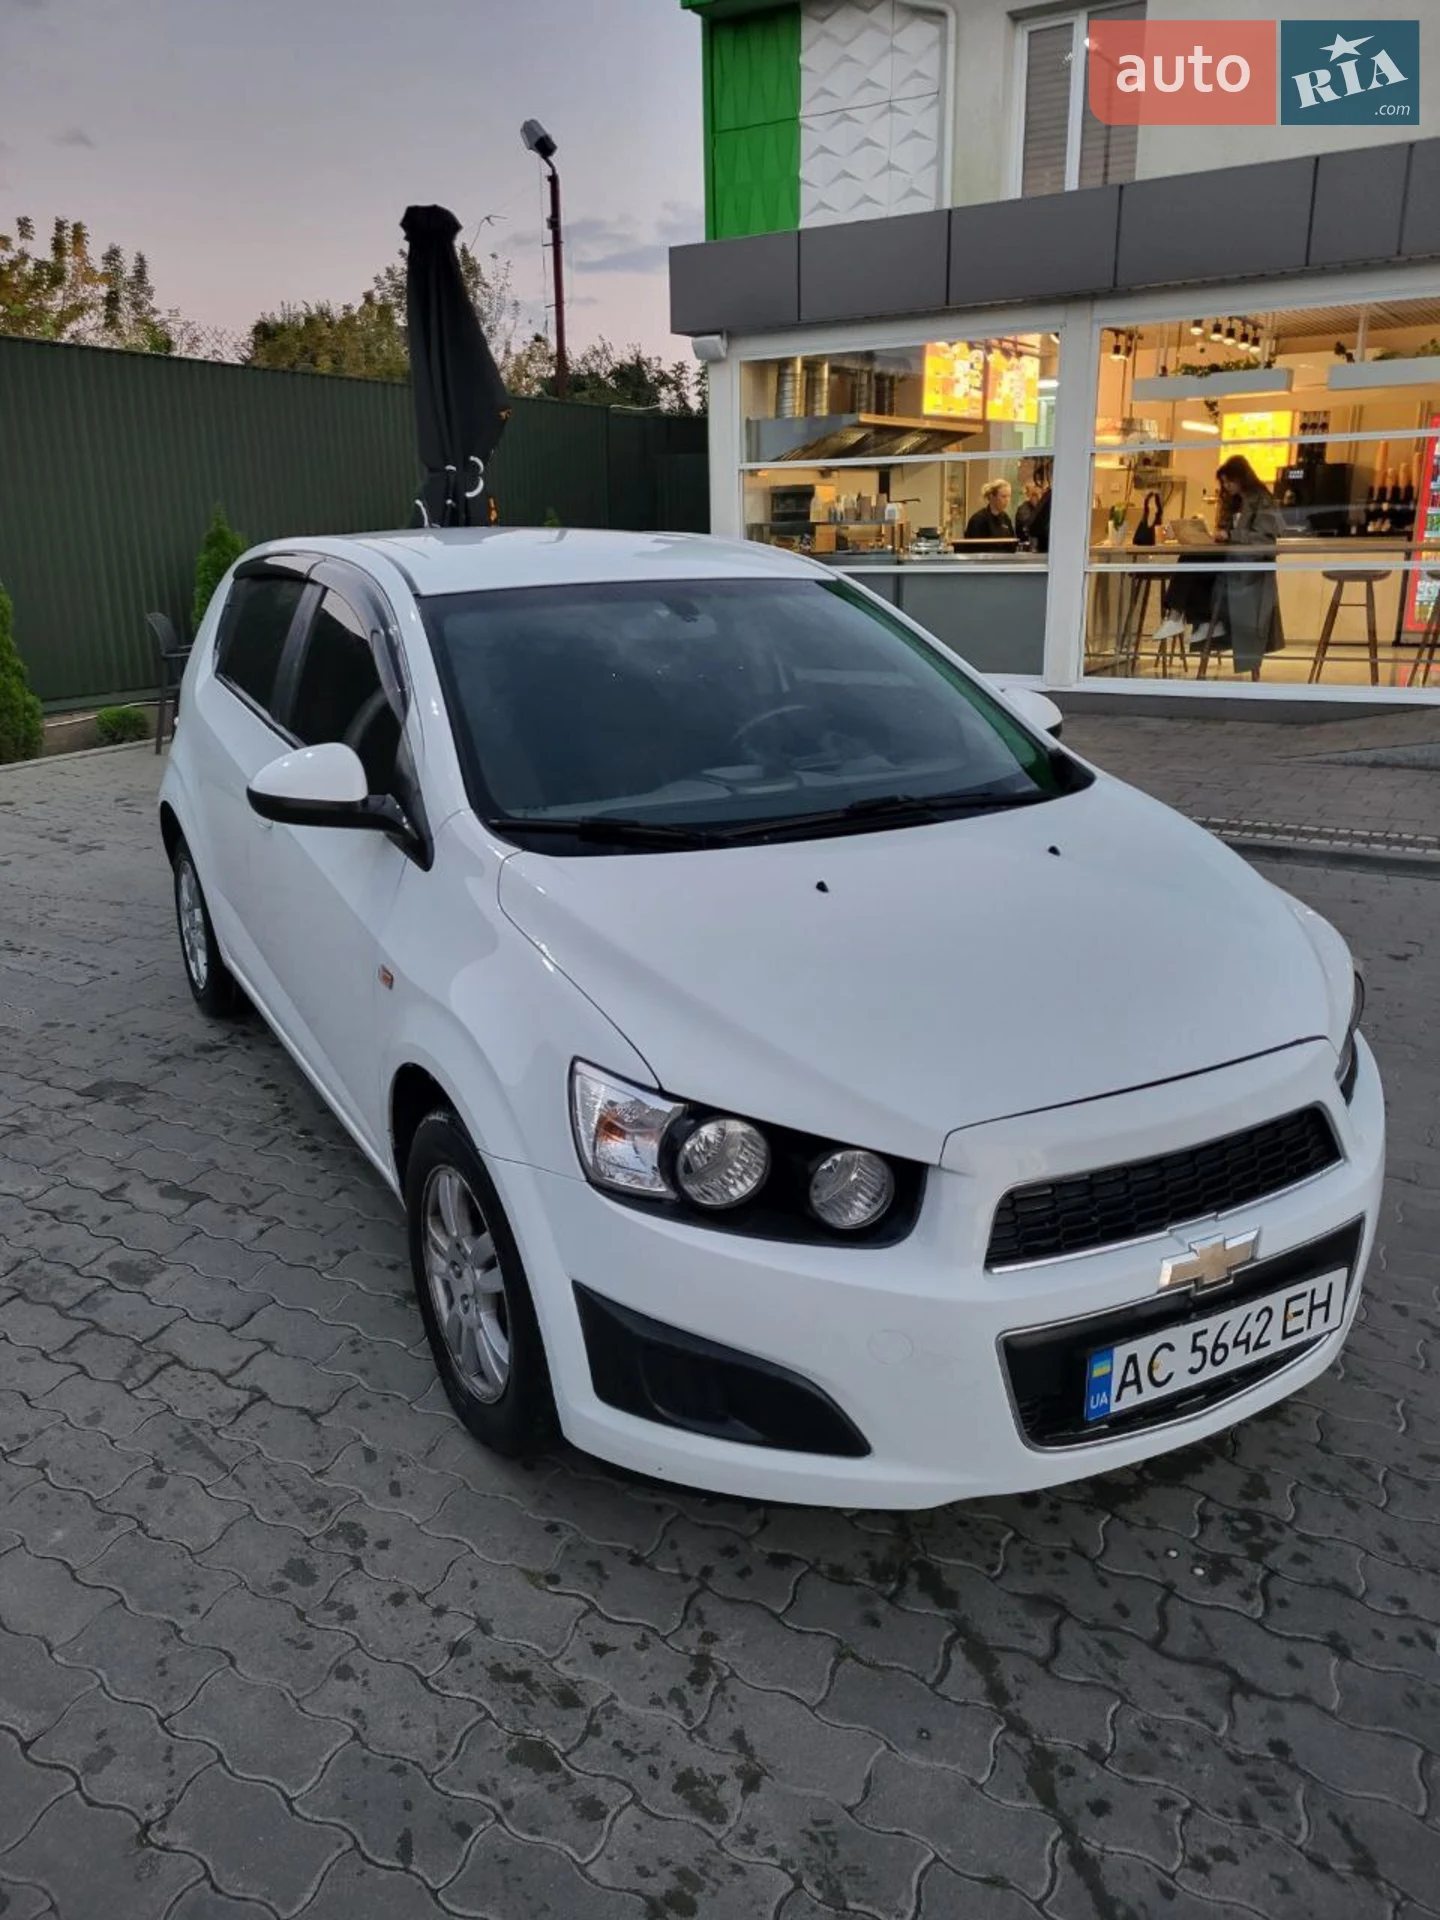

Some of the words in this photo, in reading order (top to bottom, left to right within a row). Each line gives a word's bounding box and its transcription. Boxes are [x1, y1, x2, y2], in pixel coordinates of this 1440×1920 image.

[1114, 1341, 1176, 1403] AC
[1188, 1305, 1274, 1375] 5642
[1281, 1281, 1333, 1341] EH
[1090, 1391, 1108, 1409] UA
